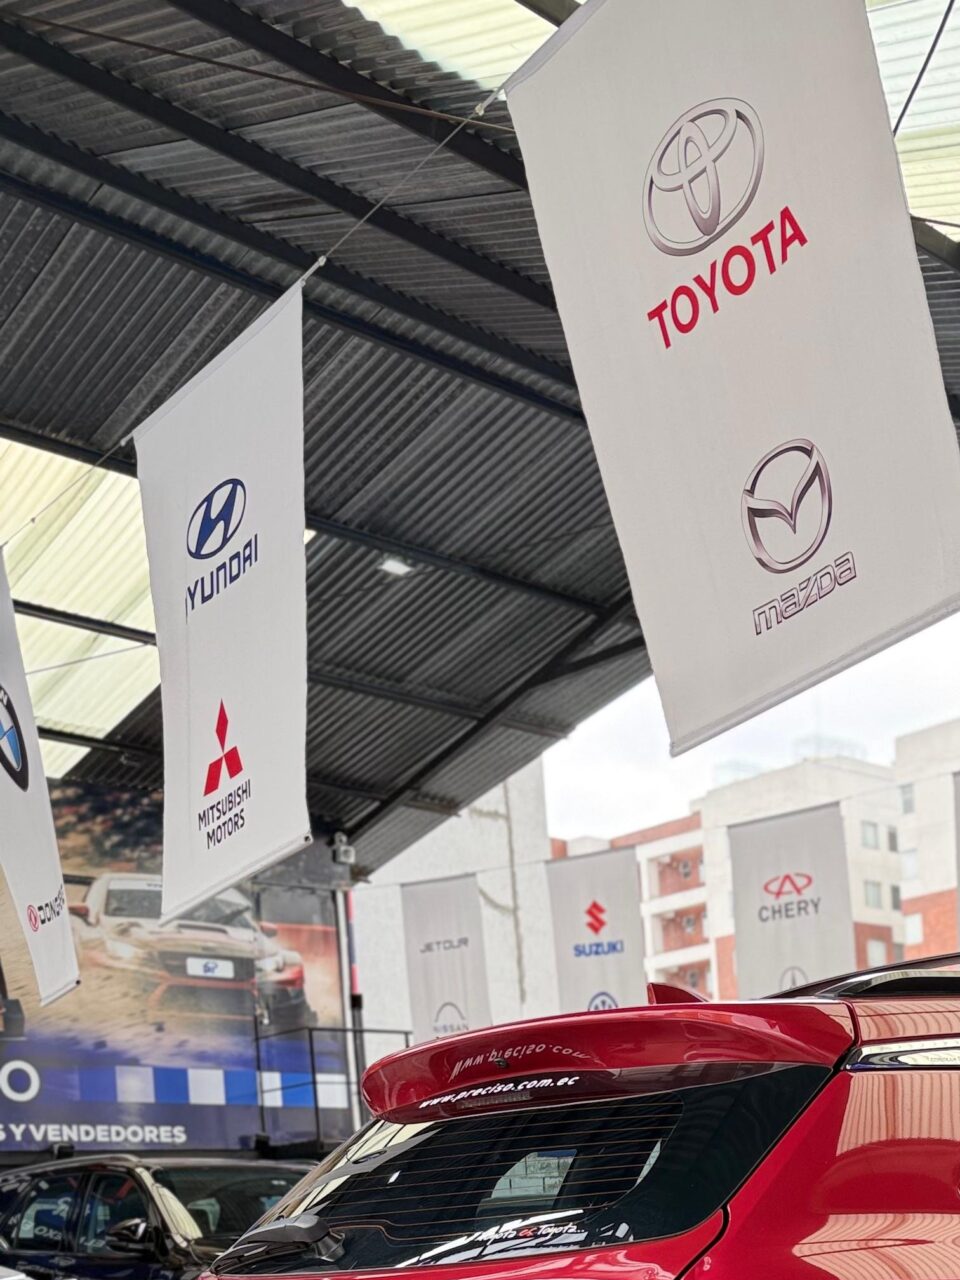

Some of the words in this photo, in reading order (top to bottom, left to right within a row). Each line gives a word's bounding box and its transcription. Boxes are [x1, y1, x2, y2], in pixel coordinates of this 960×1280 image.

[647, 205, 808, 350] TOYOTA
[185, 533, 258, 622] YUNDAI
[198, 778, 251, 832] MITSUBISHI
[206, 808, 245, 850] MOTORS
[758, 898, 822, 922] CHERY
[420, 937, 469, 953] JETOUR
[573, 940, 625, 957] SUZUKI
[418, 1075, 580, 1109] www.preciso.com.ec
[9, 1124, 27, 1142] Y
[29, 1124, 187, 1143] VENDEDORES
